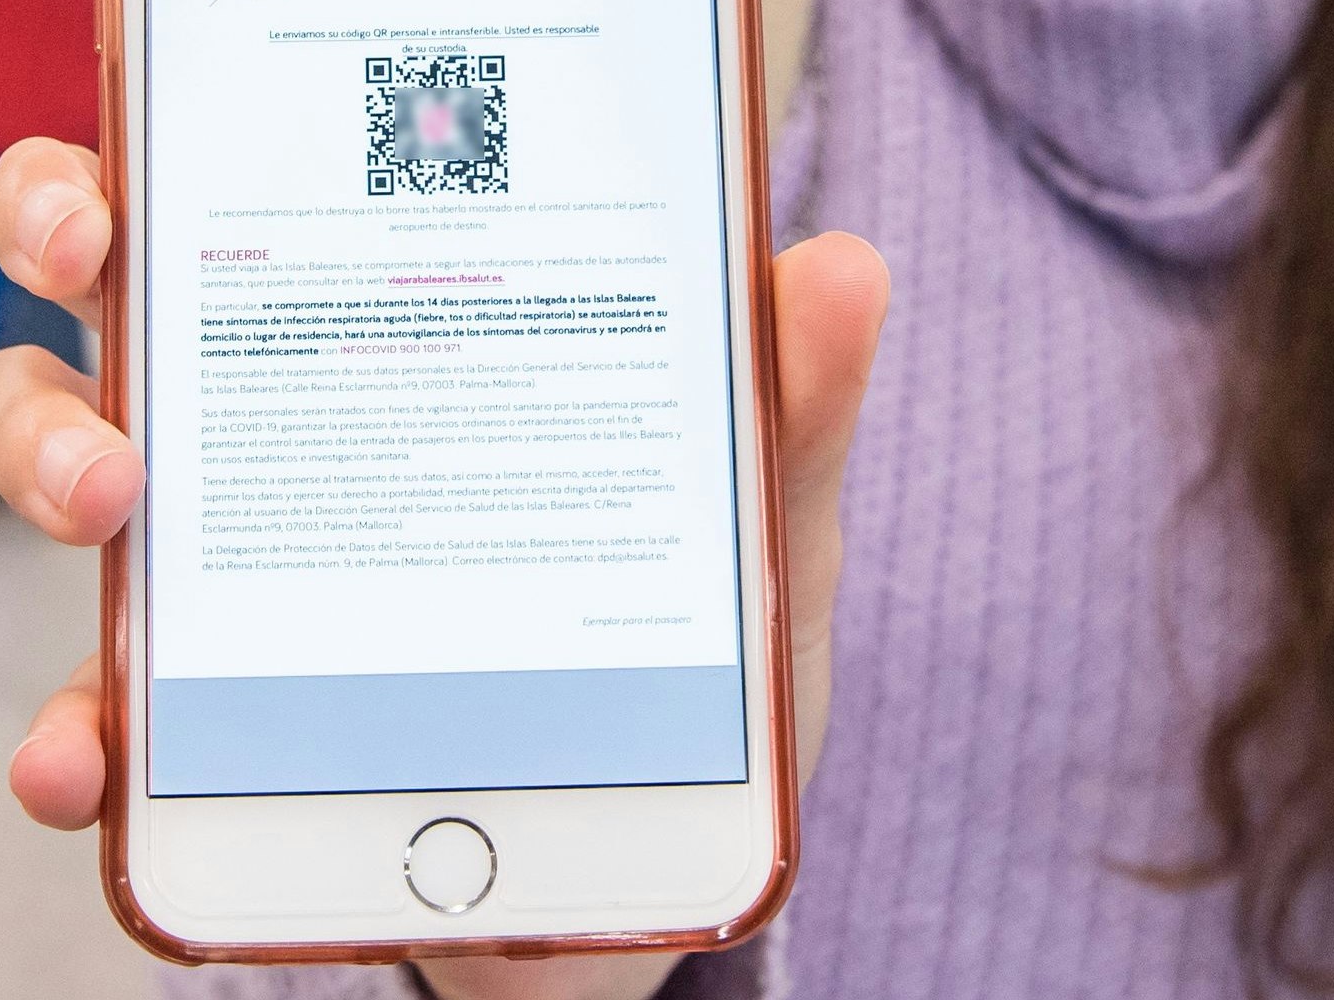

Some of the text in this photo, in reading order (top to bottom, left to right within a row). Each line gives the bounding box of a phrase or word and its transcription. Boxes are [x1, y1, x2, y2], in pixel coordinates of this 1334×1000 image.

[269, 29, 280, 38] Le
[282, 29, 326, 38] enviamos
[341, 28, 371, 40] código
[373, 28, 387, 38] QR
[390, 27, 429, 39] personal
[504, 26, 531, 35] Usted
[545, 25, 599, 37] responsable
[402, 44, 413, 53] de
[209, 208, 220, 218] Le
[222, 207, 294, 217] recomendamos
[295, 209, 313, 218] que
[315, 207, 324, 216] lo
[325, 206, 365, 218] destruya
[375, 206, 384, 215] lo
[385, 205, 410, 214] borre
[413, 206, 430, 214] tras
[432, 204, 466, 214] haberlo
[468, 203, 513, 213] mostrado
[528, 203, 536, 212] el
[538, 202, 571, 212] control
[572, 202, 611, 211] sanitario
[612, 201, 627, 210] del
[629, 202, 658, 212] puerto
[389, 223, 438, 234] aeropuerto
[439, 221, 452, 230] de
[201, 249, 269, 261] RECUERDE
[275, 301, 334, 312] compromete
[344, 302, 361, 311] que
[363, 300, 371, 308] si
[373, 298, 409, 308] durante
[411, 298, 425, 307] los
[427, 298, 438, 307] 14
[461, 297, 513, 309] posteriores
[523, 296, 532, 305] la
[533, 295, 567, 307] llegada
[577, 295, 591, 304] las
[593, 294, 614, 304] Islas
[617, 293, 656, 303] Baleares
[201, 318, 223, 327] tiene
[270, 316, 282, 325] de
[328, 315, 381, 326] respiratoria
[383, 314, 411, 325] aguda
[449, 314, 464, 322] tos
[474, 312, 517, 321] dificultad
[519, 310, 575, 323] respiratoria)
[591, 309, 641, 319] autoaislará
[200, 332, 243, 342] domicilio
[253, 331, 276, 343] lugar
[279, 331, 291, 340] de
[293, 330, 342, 342] residencia,
[345, 330, 365, 339] hará
[387, 328, 451, 340] autovigilancia
[453, 328, 464, 337] de
[467, 327, 480, 337] los
[527, 326, 541, 335] del
[543, 326, 597, 335] coronavirus
[620, 324, 652, 336] pondrá
[201, 349, 241, 357] contacto
[243, 346, 319, 356] telefónicamente
[340, 345, 397, 355] INFOCOVID
[399, 344, 420, 353] 900
[423, 344, 441, 353] 100
